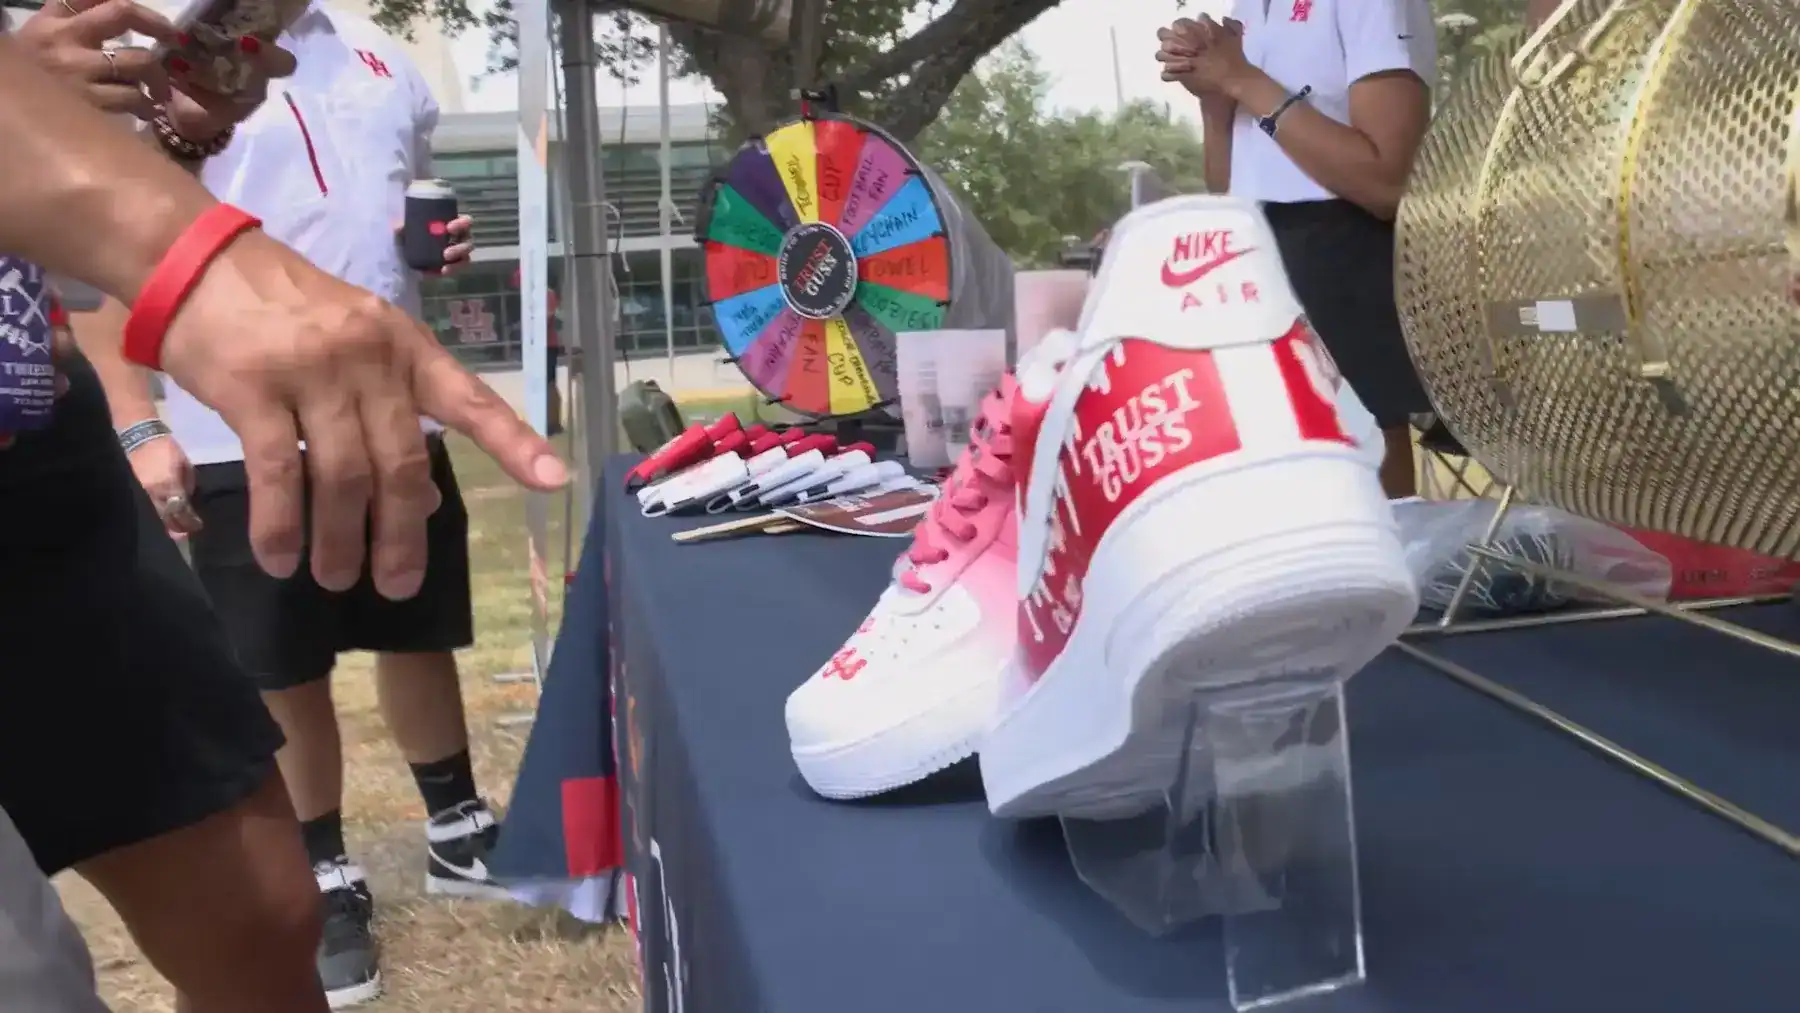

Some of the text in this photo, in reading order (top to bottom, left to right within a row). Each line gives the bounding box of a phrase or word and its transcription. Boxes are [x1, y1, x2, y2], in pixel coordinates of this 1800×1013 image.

[821, 156, 843, 202] CUP
[867, 169, 889, 202] FAN
[792, 237, 833, 295] TRUST
[1173, 228, 1234, 263] NIKE
[805, 253, 838, 297] GUSS
[1181, 281, 1261, 312] AIR
[802, 332, 823, 374] FAN
[827, 351, 855, 388] CUP
[1081, 368, 1202, 485] TRUST
[1102, 409, 1193, 503] GUSS
